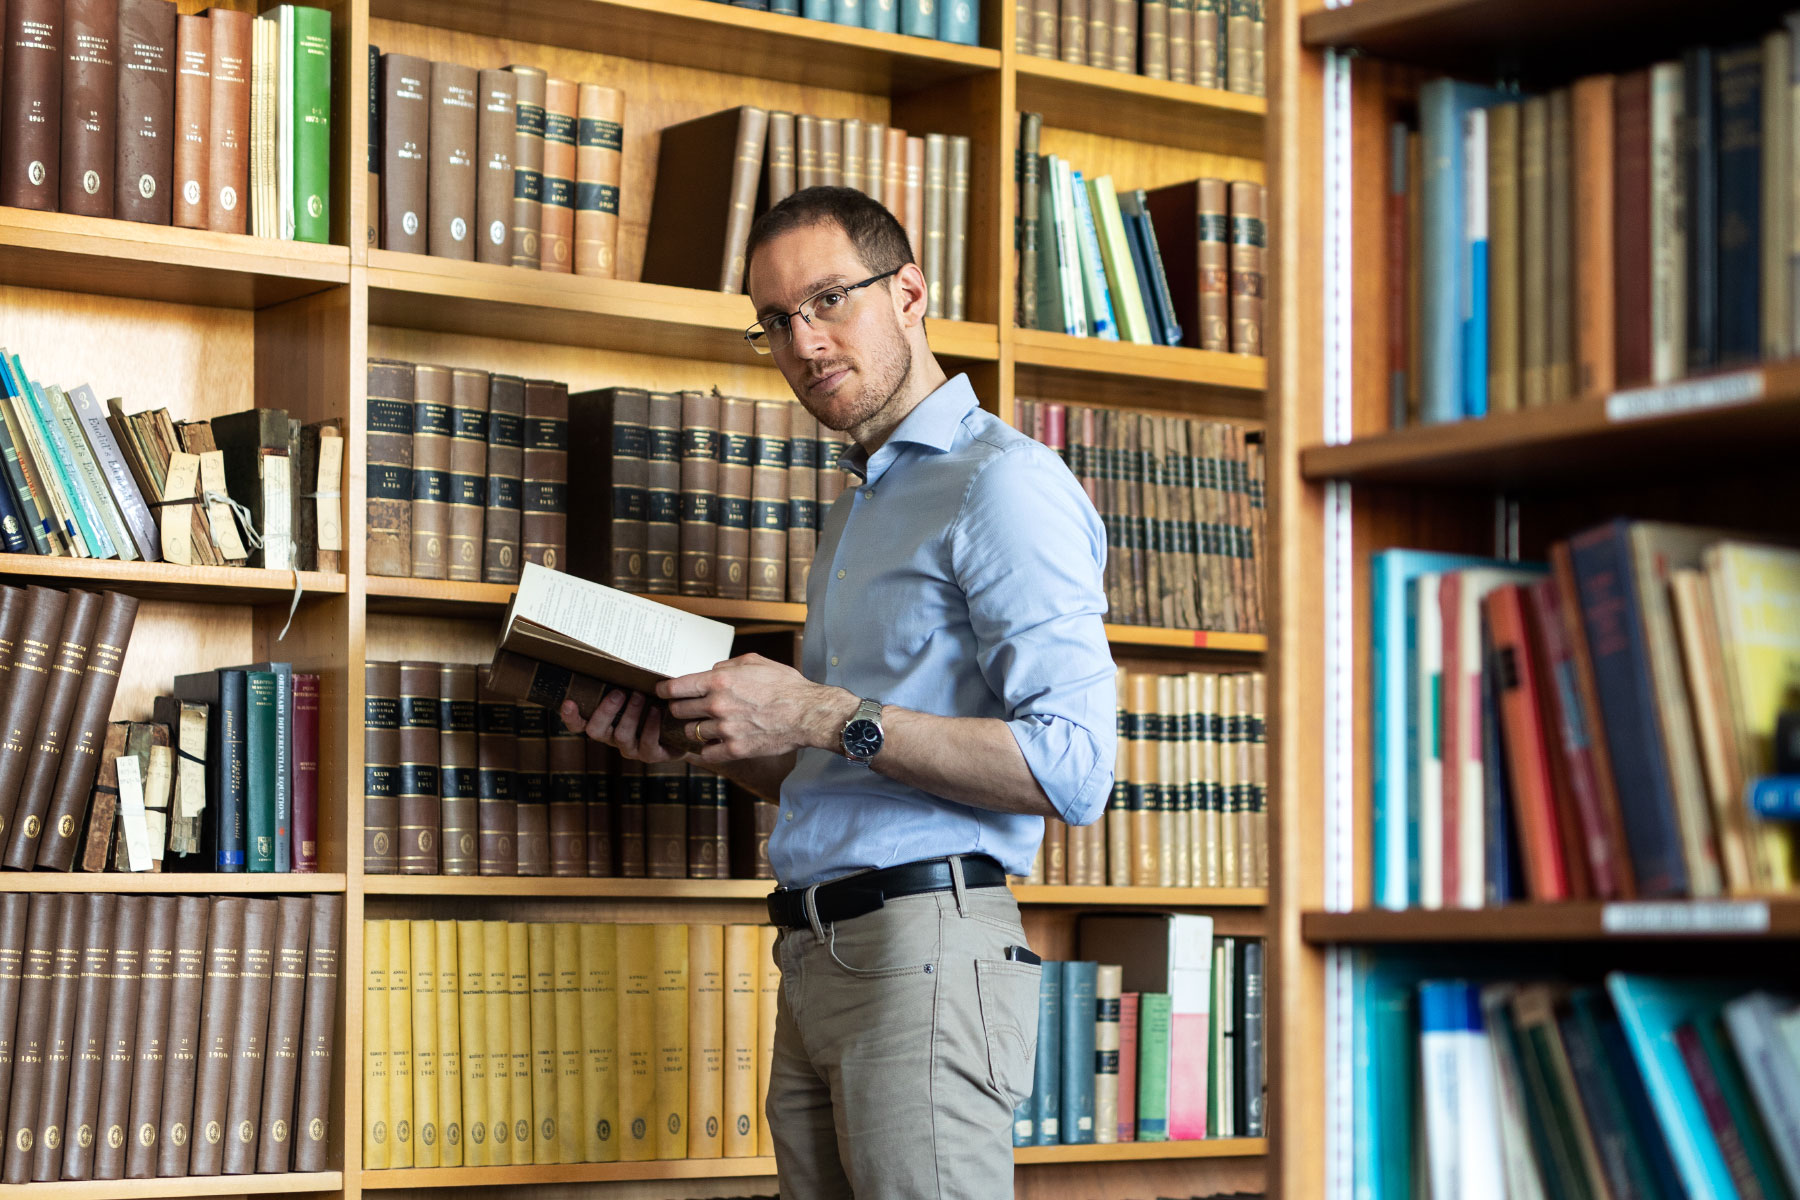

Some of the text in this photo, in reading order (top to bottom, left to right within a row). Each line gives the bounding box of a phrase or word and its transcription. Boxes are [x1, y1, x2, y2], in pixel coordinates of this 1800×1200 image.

[78, 392, 90, 410] 3
[88, 418, 112, 457] Euclid's
[53, 394, 108, 506] 2 Euclid's Elements
[24, 640, 48, 648] AMERICAN
[62, 642, 86, 652] AMERICAN
[97, 643, 122, 653] AMERICAN
[24, 647, 46, 656] JOURNAL
[62, 649, 84, 659] JOURNAL
[97, 651, 118, 661] JOURNAL
[3, 742, 22, 752] 1917
[40, 744, 60, 754] 1919
[75, 744, 94, 754] 1918
[21, 1055, 42, 1063] 1894
